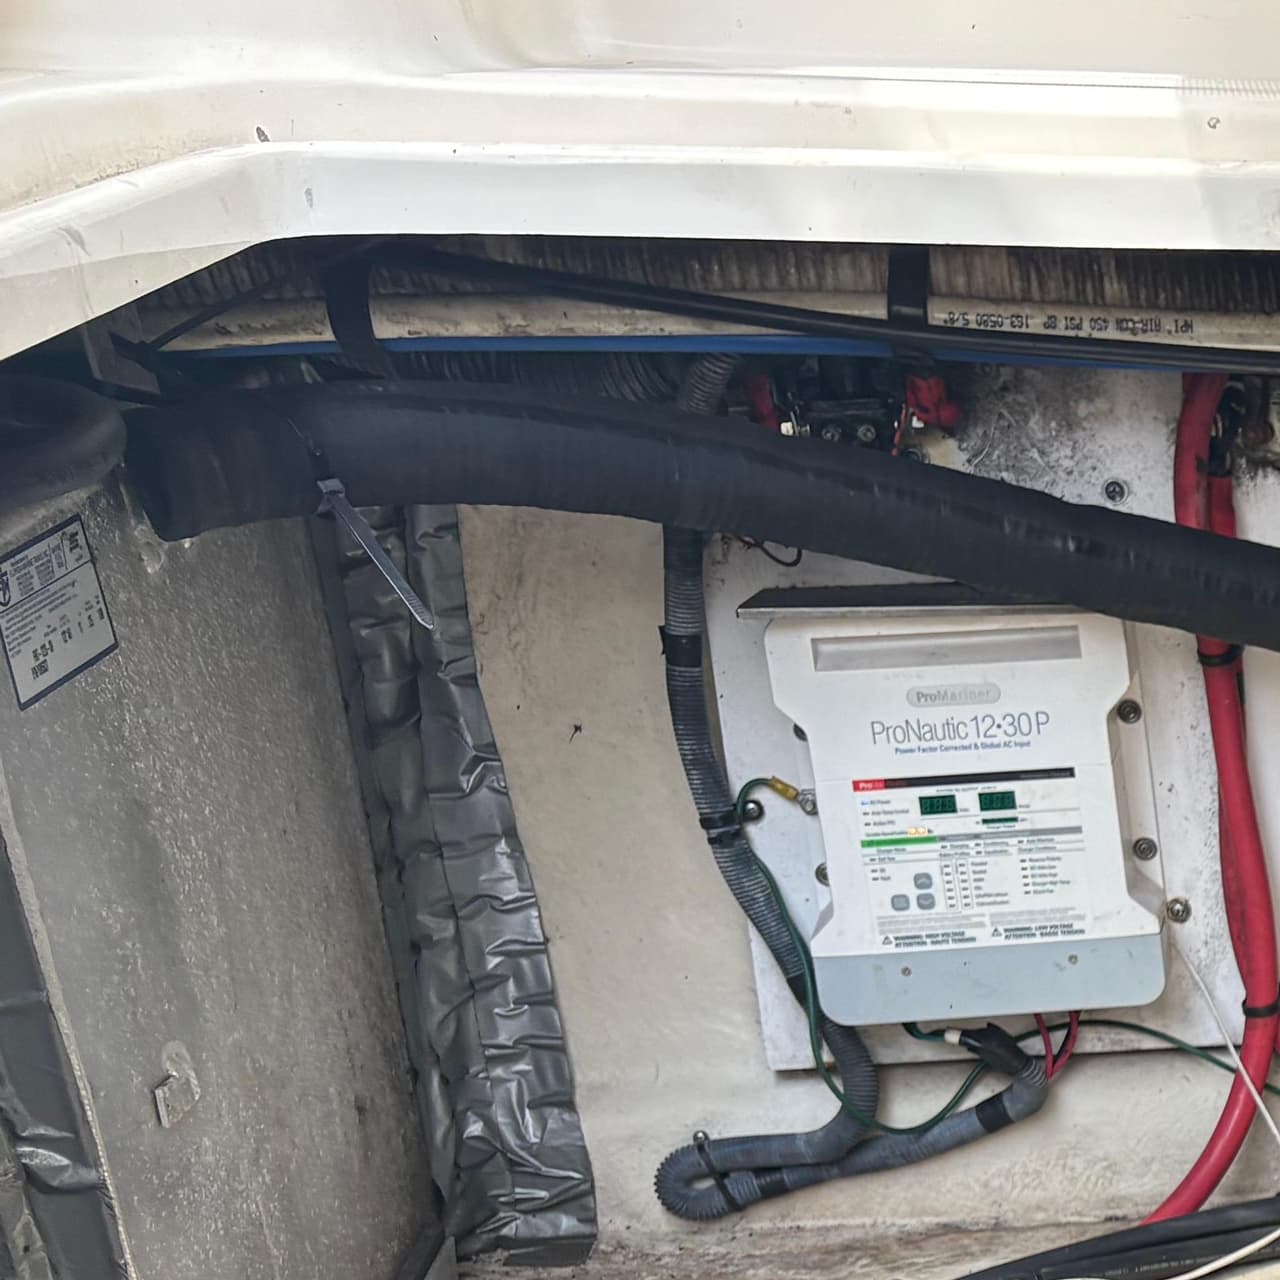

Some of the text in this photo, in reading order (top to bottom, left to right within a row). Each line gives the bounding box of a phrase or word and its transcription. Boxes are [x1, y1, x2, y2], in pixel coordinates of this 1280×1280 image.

[1063, 317, 1083, 331] PSI
[1089, 319, 1109, 332] 450
[916, 687, 991, 703] ProMariner
[871, 716, 968, 745] ProNautic
[940, 743, 972, 753] Corrected
